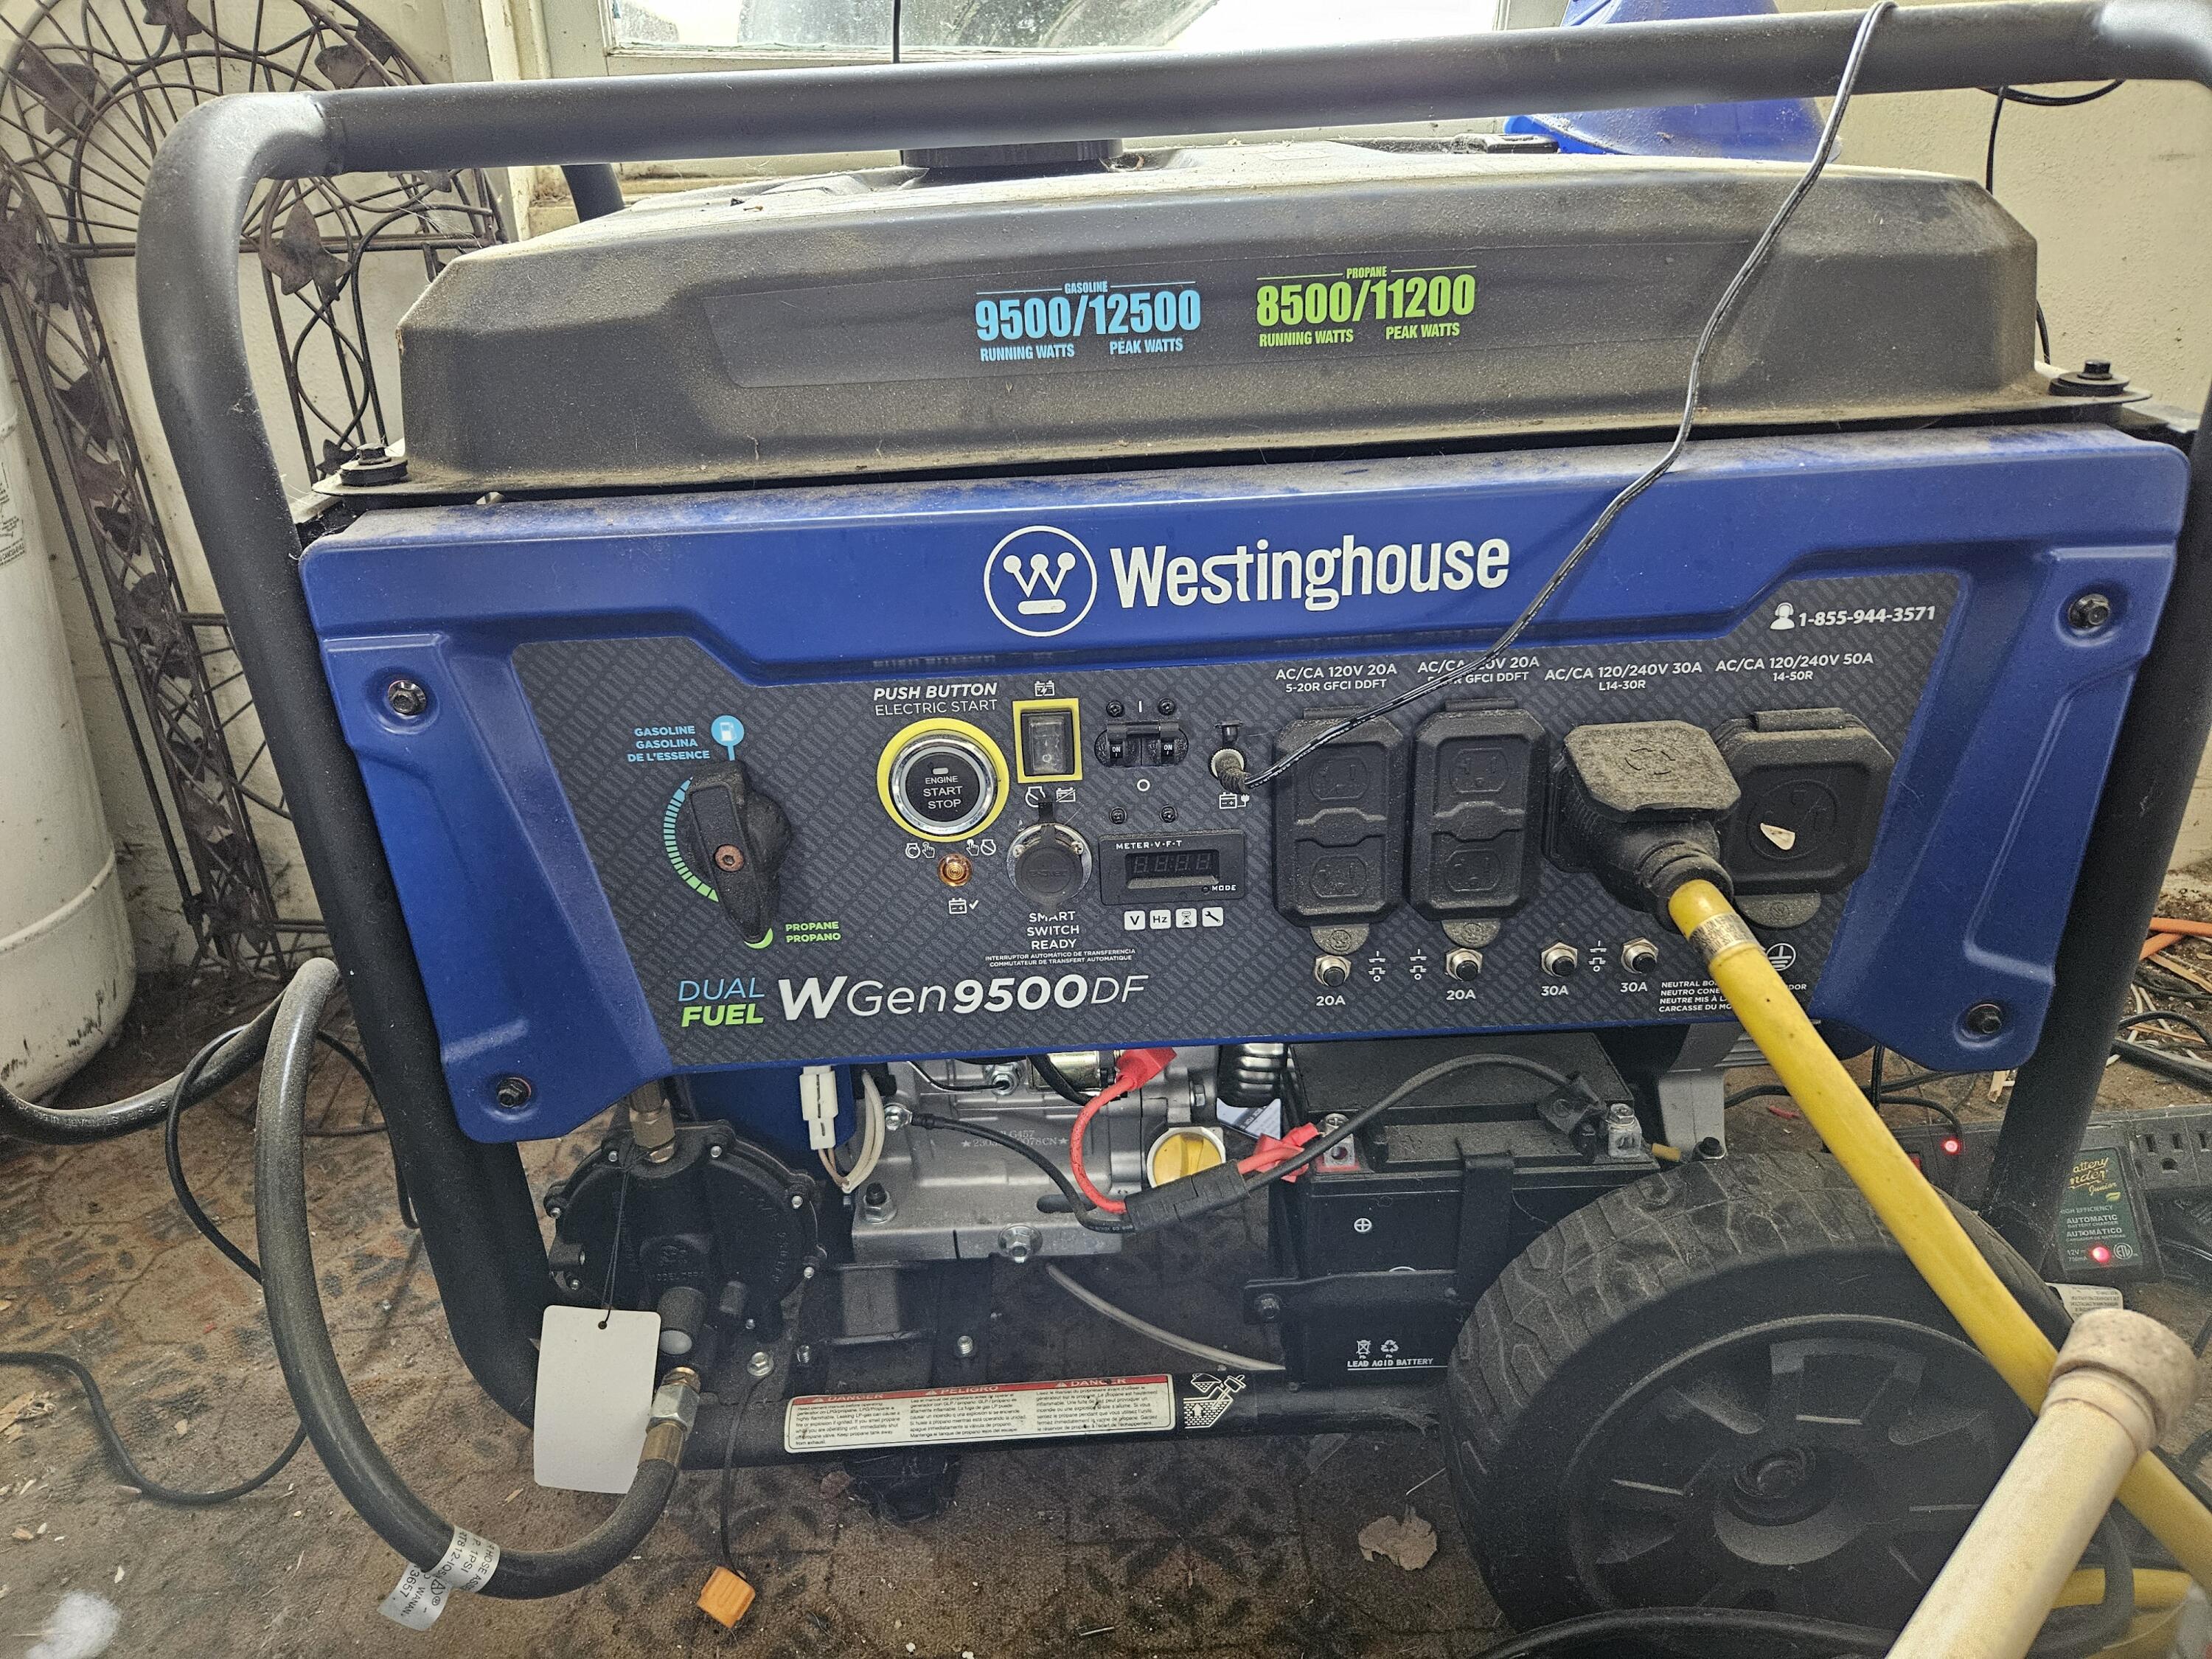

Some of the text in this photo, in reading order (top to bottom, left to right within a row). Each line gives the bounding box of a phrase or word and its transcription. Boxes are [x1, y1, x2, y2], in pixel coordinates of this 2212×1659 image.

[1346, 265, 1388, 279] PROPANE
[1064, 281, 1108, 294] GASOLINE
[1256, 274, 1475, 327] 8500/11200
[974, 289, 1202, 342] 9500/12500
[1258, 322, 1461, 347] RUNNING WATTS PEAK WATTS
[979, 337, 1184, 361] RUNNING WATTS PEAK WATTS
[1110, 534, 1511, 611] Westinghouse
[1798, 605, 1936, 627] 1-855-944-3571
[1509, 655, 1540, 669] 20A
[1715, 653, 1874, 672] AC/CA 120/240V 50A
[1275, 663, 1398, 681] AC/CA 120V 20A
[1465, 673, 1493, 684] GFCI
[1496, 671, 1530, 683] DDFT
[1545, 661, 1703, 681] AC/CA 120/240V 30A
[1772, 669, 1814, 682] 14-50R
[873, 682, 998, 701] PUSH BUTTON
[1285, 678, 1388, 693] 5-20R GFCI DDFT
[1599, 679, 1646, 691] L14-30R
[874, 699, 998, 717] ELECTRIC START
[633, 725, 696, 737] GASOLINE
[635, 737, 699, 750] GASOLINA
[627, 748, 712, 762] DE L'ESSENCE
[924, 774, 959, 785] ENGINE
[922, 785, 962, 798] START
[927, 797, 961, 810] STOP
[1029, 910, 1076, 922] SMART
[1130, 914, 1168, 925] V Hz
[785, 920, 840, 933] PROPANE
[1026, 925, 1079, 936] SWITCH
[785, 931, 841, 943] PROPANO
[1031, 938, 1077, 950] READY
[985, 953, 1029, 961] INTERRUPTOR
[1084, 948, 1136, 957] TRANSFERENCIA
[990, 959, 1037, 967] COMMUTATEUR
[1048, 957, 1085, 965] TRANSFERT
[1087, 955, 1133, 963] AUTOMATIQUE
[677, 977, 765, 1002] DUAL
[1541, 985, 1569, 997] 30A
[1620, 981, 1649, 993] 30A
[1315, 995, 1346, 1007] 20A
[1446, 989, 1476, 1001] 20A
[1658, 1004, 1703, 1012] CARCASSE
[681, 1003, 765, 1028] FUEL
[2073, 1157, 2109, 1174] attery
[2088, 1182, 2118, 1196] Junior
[2066, 1214, 2118, 1224] AUTOMATIC
[1347, 1358, 1434, 1368] LEAD ACID BATTERY
[941, 1386, 999, 1394] PELIGRO
